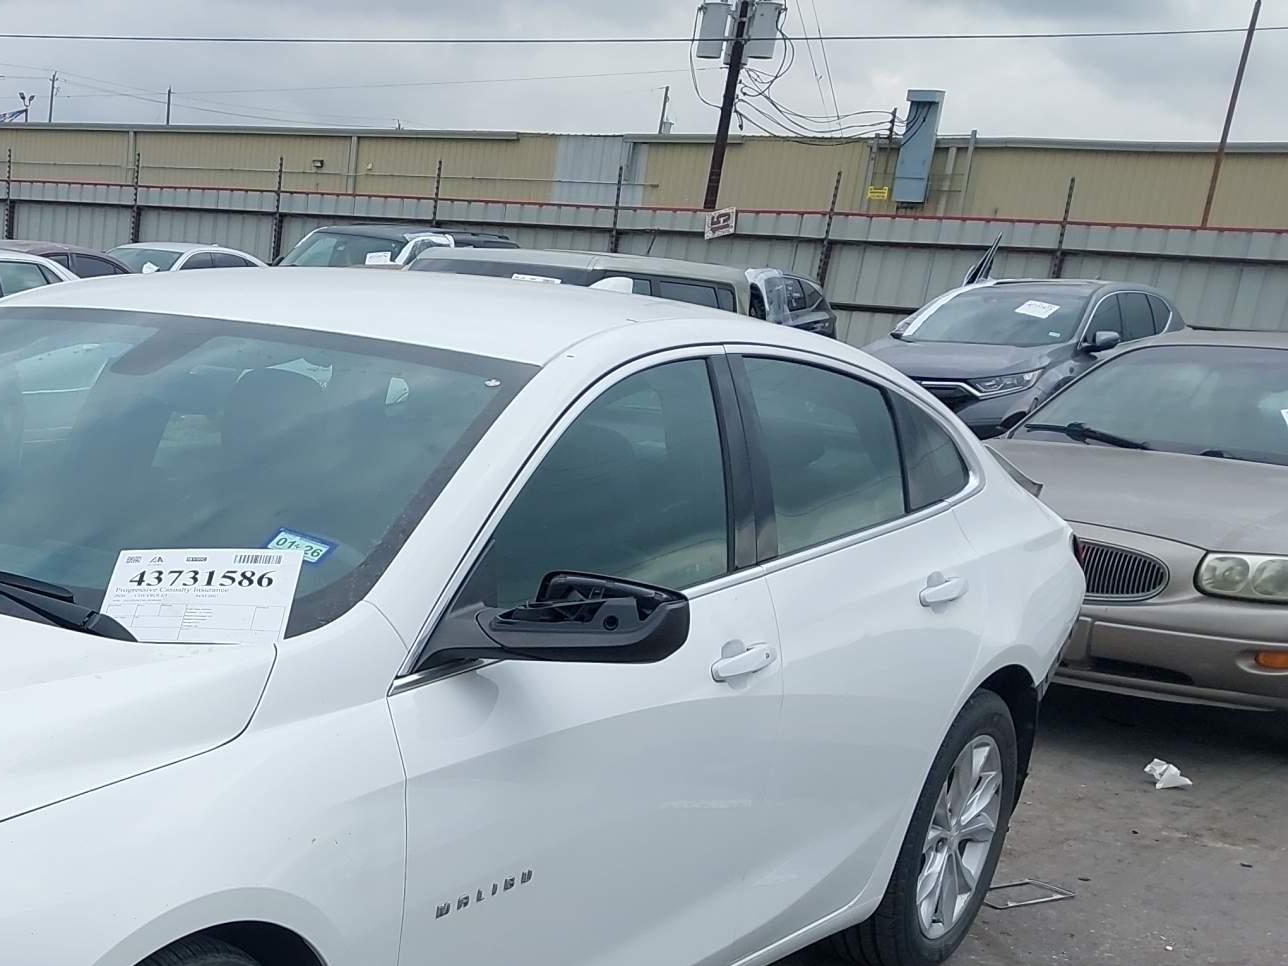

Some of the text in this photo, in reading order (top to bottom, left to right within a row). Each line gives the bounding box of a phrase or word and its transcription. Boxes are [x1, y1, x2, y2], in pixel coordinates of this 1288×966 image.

[275, 537, 323, 558] 01 26
[128, 570, 275, 587] 43731586
[435, 869, 534, 919] MALIBU
